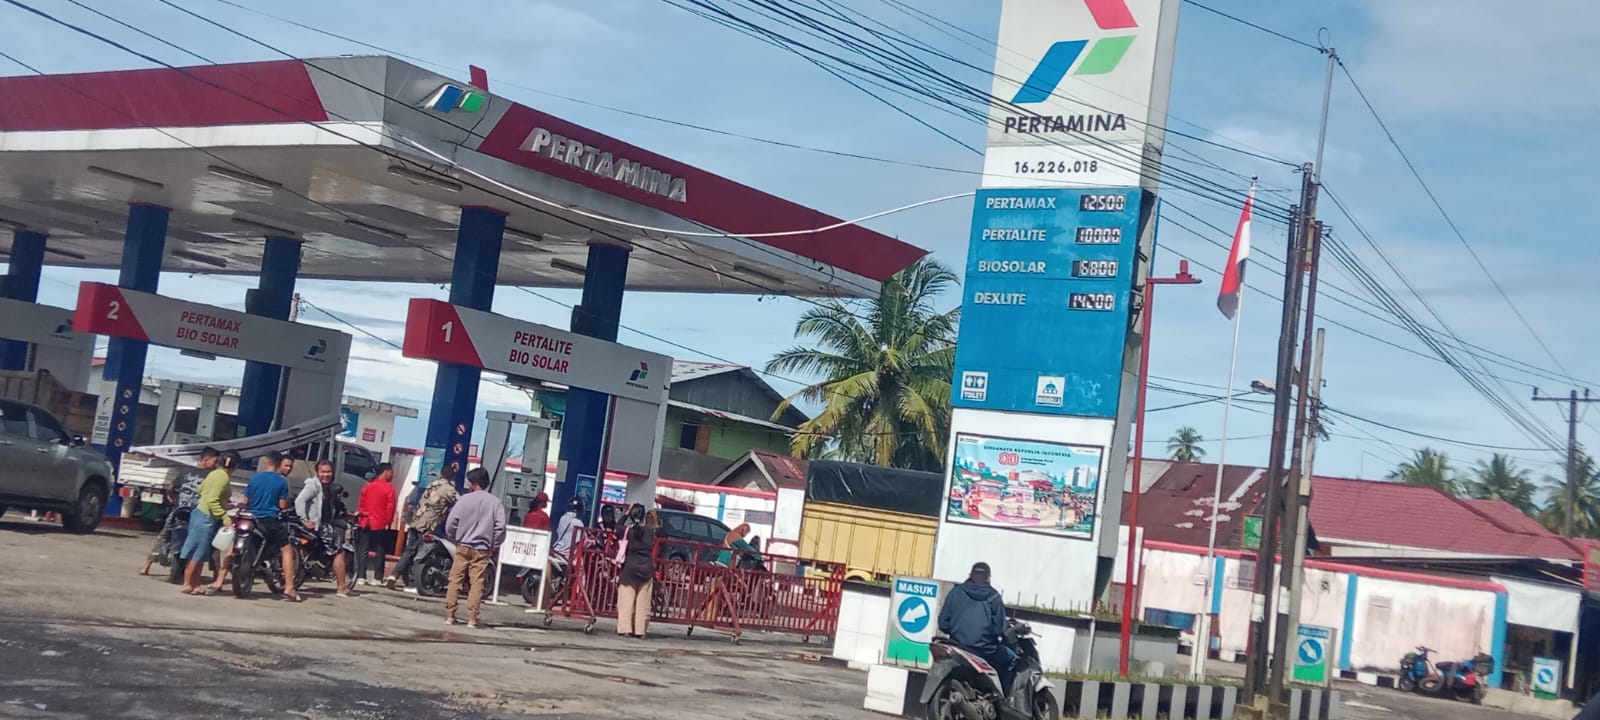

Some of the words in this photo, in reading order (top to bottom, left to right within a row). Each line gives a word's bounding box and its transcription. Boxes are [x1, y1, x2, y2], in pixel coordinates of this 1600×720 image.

[1004, 114, 1127, 134] PERTAMINA
[523, 127, 687, 203] PERTAMINA
[1014, 161, 1098, 174] 16.226.018
[985, 197, 1056, 210] PERTAMAX
[1084, 195, 1126, 211] 12500
[982, 229, 1047, 242] PERTALITE
[1079, 228, 1121, 244] 10000
[978, 260, 1046, 274] BIOSOLAR
[107, 301, 119, 320] 2
[974, 292, 1027, 305] DEXLITE
[1073, 294, 1114, 310] 14200
[180, 311, 243, 333] PERTAMAX
[176, 327, 198, 341] BIO
[200, 331, 239, 349] SOLAR
[441, 321, 453, 343] 1
[513, 331, 573, 355] PERTALITE
[508, 349, 529, 365] BIO
[531, 355, 569, 374] SOLAR
[898, 581, 933, 595] MASUK
